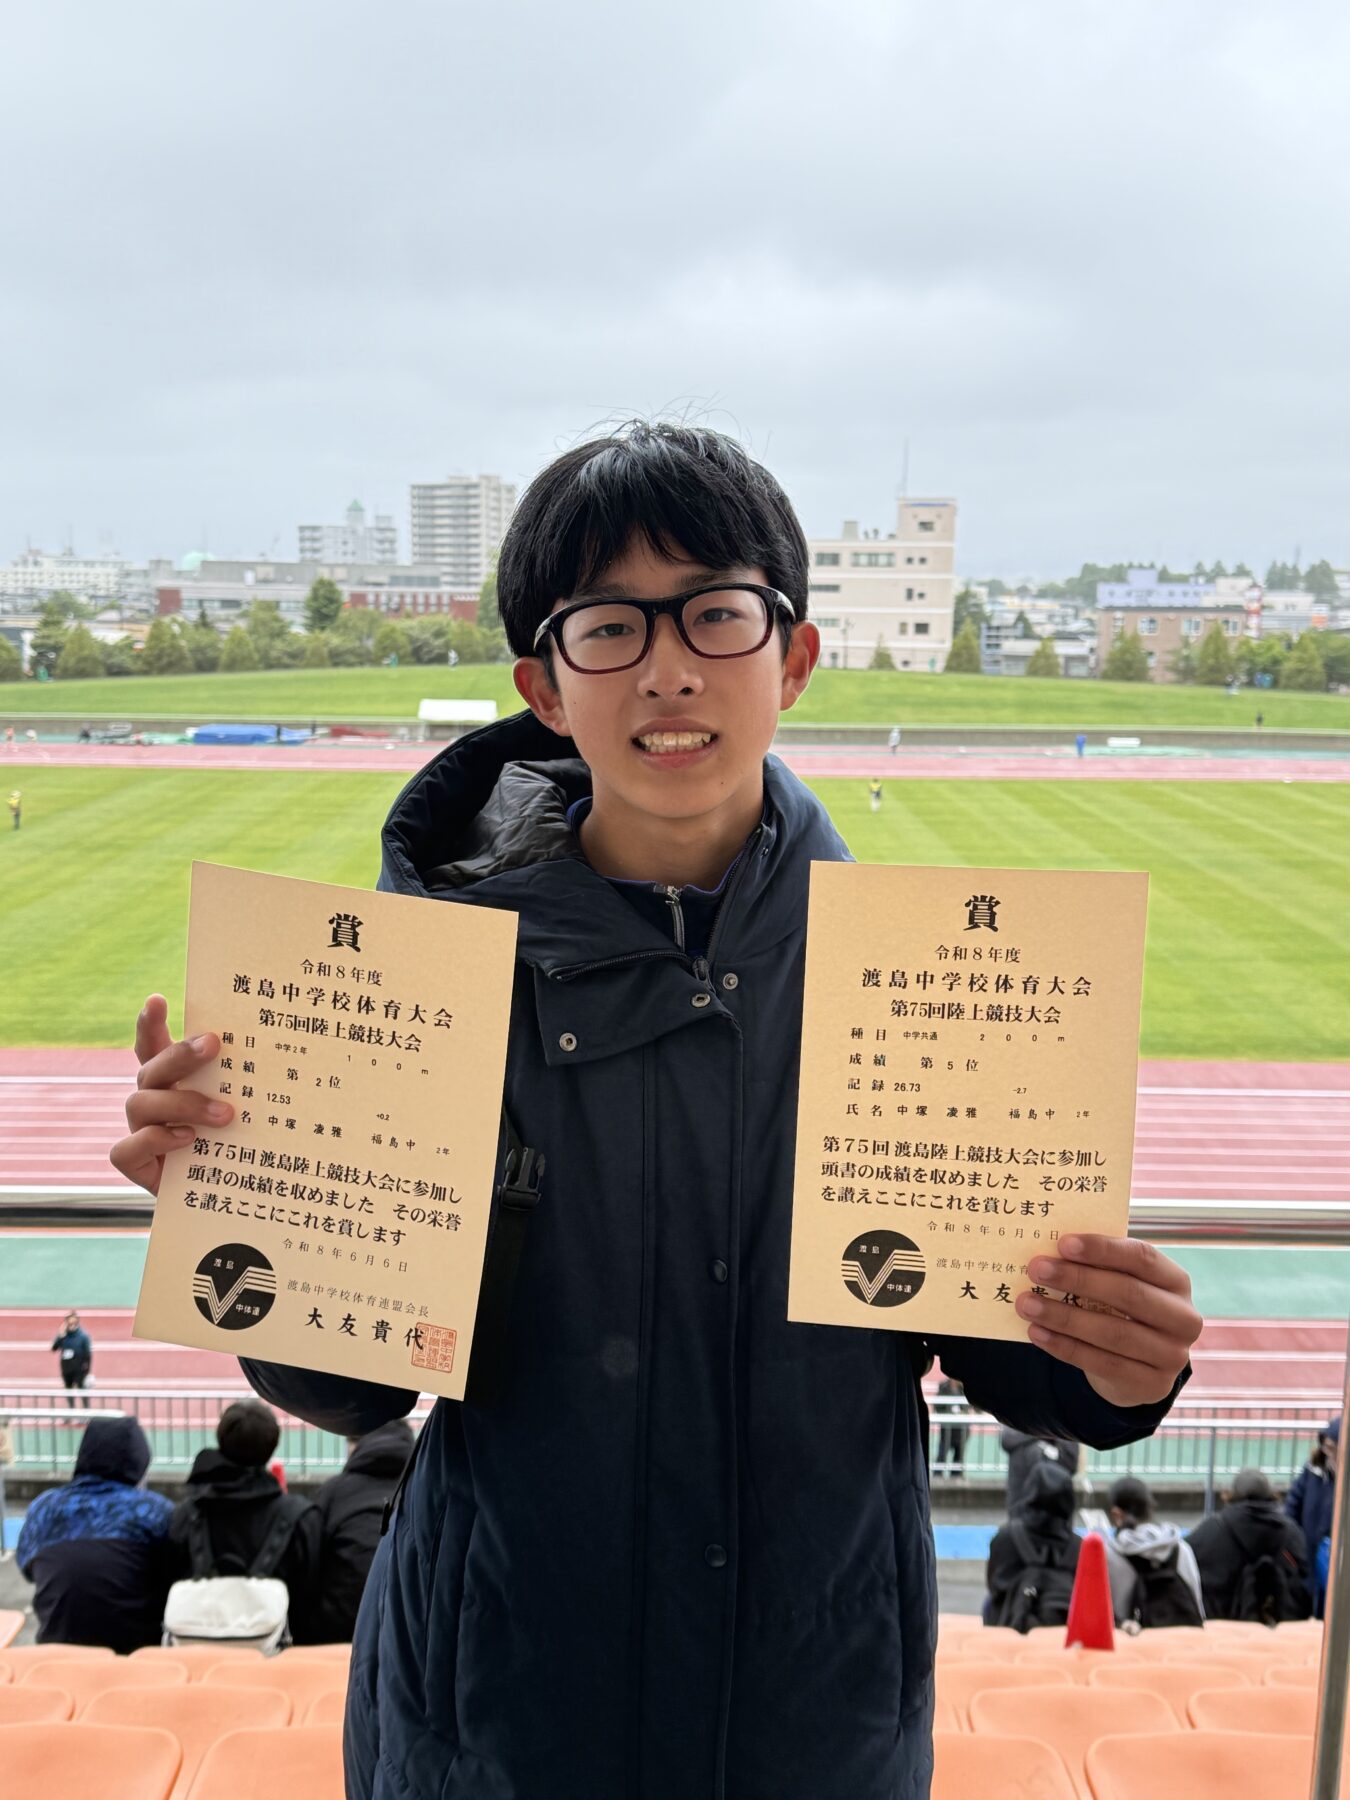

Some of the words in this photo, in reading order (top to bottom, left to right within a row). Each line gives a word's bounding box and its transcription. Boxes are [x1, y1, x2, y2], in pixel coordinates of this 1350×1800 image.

[963, 895, 1001, 932] 賞
[328, 913, 364, 952] 賞
[934, 945, 1021, 963] 令和8年度
[300, 959, 383, 986] 令和8年度
[862, 968, 1092, 996] 渡島中学校体育大会
[232, 974, 453, 1029] 渡島中学校体育大会
[890, 1000, 1061, 1024] 第75回陸上競技大会
[222, 1031, 255, 1048] 種目
[275, 1042, 308, 1055] 中学2年
[259, 1008, 422, 1052] 第75回陸上競技大会
[851, 1027, 886, 1041] 種目
[903, 1031, 938, 1041] 中学共通
[220, 1058, 255, 1074] 成績
[286, 1068, 341, 1089] 第2位
[849, 1053, 886, 1067] 成績
[920, 1057, 979, 1072] 第5位
[220, 1082, 254, 1098] 記録
[266, 1092, 291, 1104] 12.53
[848, 1078, 884, 1092] 記録
[894, 1082, 920, 1092] 26.73
[846, 1104, 883, 1117] 氏名
[897, 1105, 927, 1117] 中塚
[1009, 1108, 1055, 1120] 福島中
[268, 1115, 296, 1130] 中塚
[371, 1133, 415, 1151] 福島中
[436, 1147, 450, 1155] 2年
[823, 1136, 1107, 1167] 第75回渡島陸上競技大会に参加し
[191, 1137, 462, 1204] 第75回渡島陸上競技大会に参加し
[821, 1161, 1019, 1190] 頭書の成績を収めました
[1039, 1175, 1108, 1193] その栄誉
[187, 1164, 374, 1214] 頭書の成績を収めました
[392, 1204, 461, 1231] その栄誉
[927, 1221, 1059, 1241] 令和8年6月6日
[283, 1238, 408, 1273] 令和8年6月6日
[287, 1279, 430, 1318] 渡島中学校体育連盟会長
[305, 1308, 424, 1350] 大友貴代
